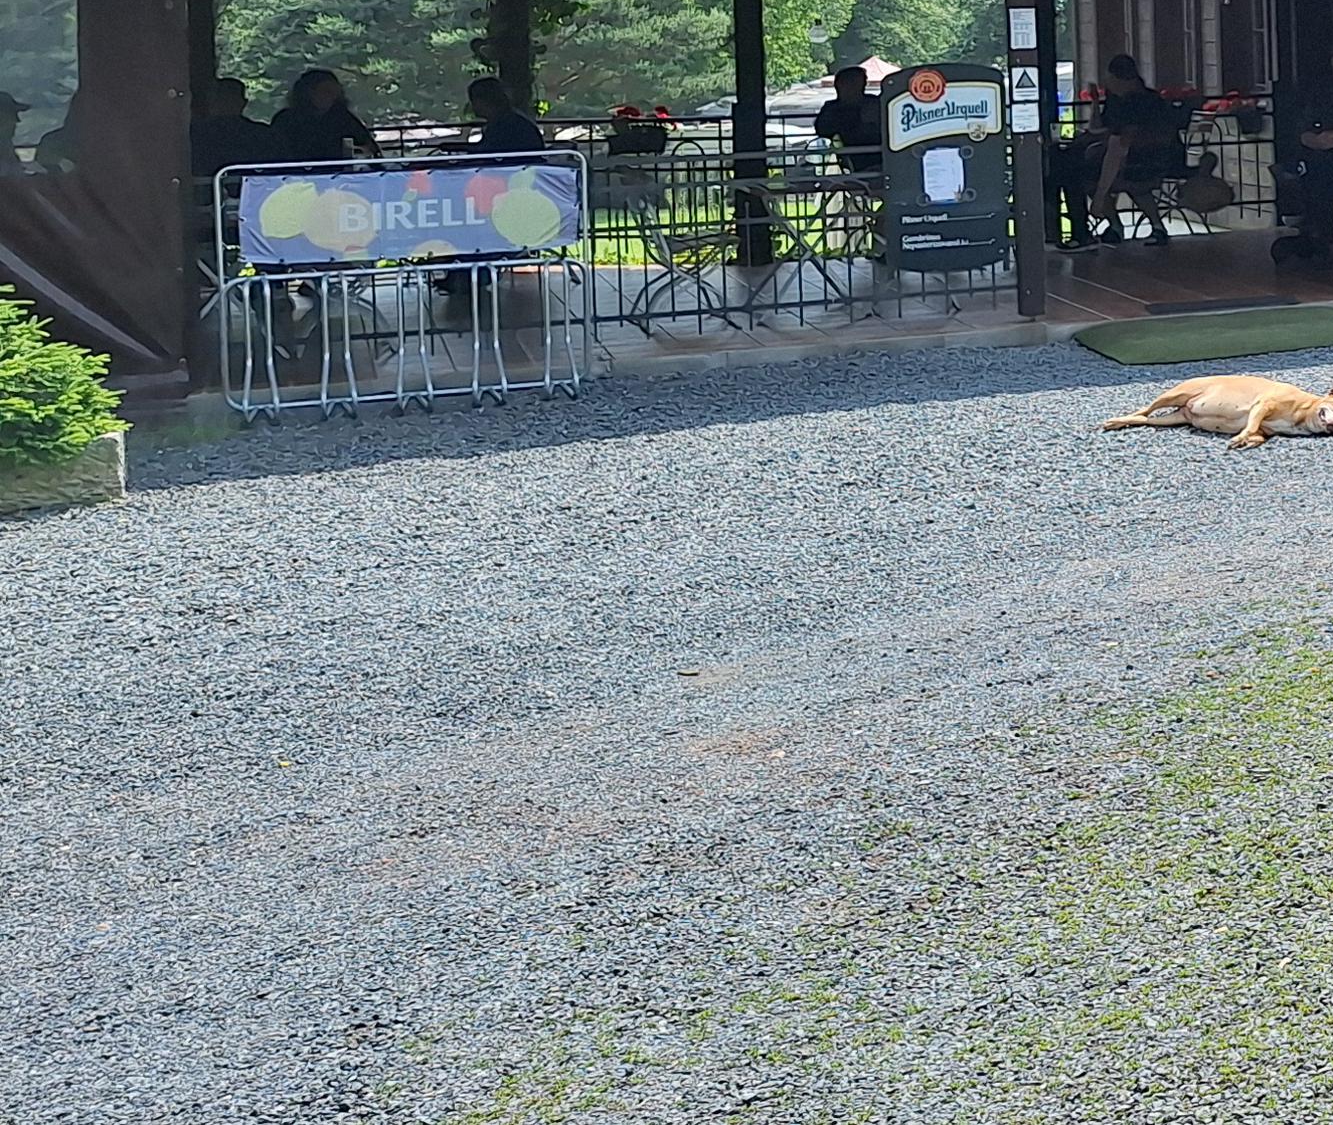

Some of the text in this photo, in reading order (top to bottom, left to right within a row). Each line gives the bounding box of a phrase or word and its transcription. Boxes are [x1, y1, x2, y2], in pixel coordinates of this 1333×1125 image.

[901, 103, 946, 132] Pilsner
[944, 100, 988, 121] Urquell
[337, 196, 487, 234] BIRELL
